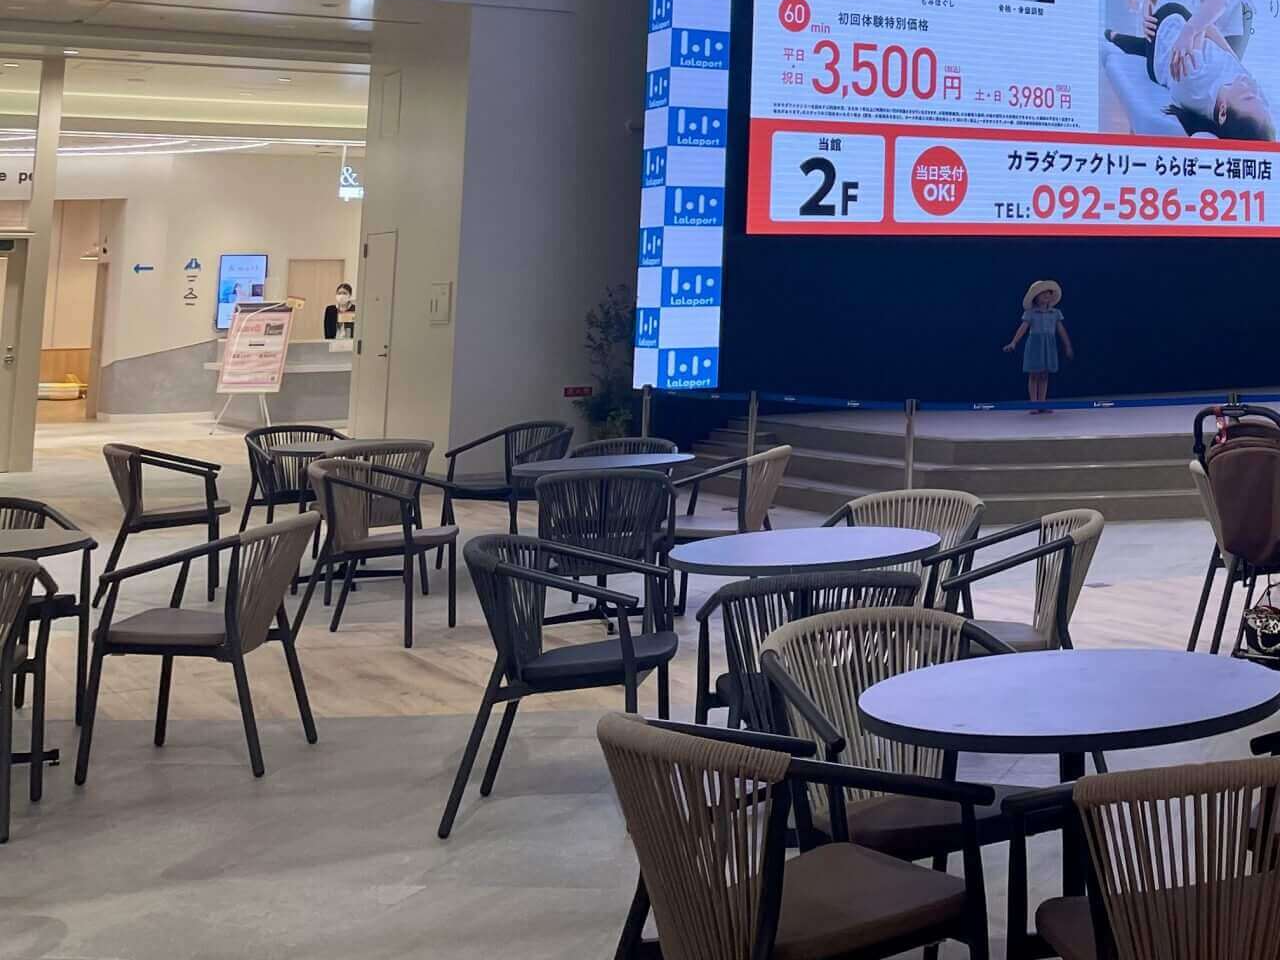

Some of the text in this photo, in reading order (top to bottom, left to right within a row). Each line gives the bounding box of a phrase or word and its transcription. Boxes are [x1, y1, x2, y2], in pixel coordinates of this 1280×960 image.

[783, 4, 831, 34] 60 min
[838, 11, 929, 32] 初回体験特別価格
[680, 57, 723, 69] LaLaport
[677, 135, 720, 147] LaLaport
[915, 164, 965, 182] 当日受付
[1007, 150, 1273, 181] カラダファクトリー ららぽーと福岡店
[923, 183, 956, 202] OK!
[674, 215, 717, 226] LaLaport
[670, 296, 714, 306] LaLaport
[666, 378, 711, 389] LaLaport
